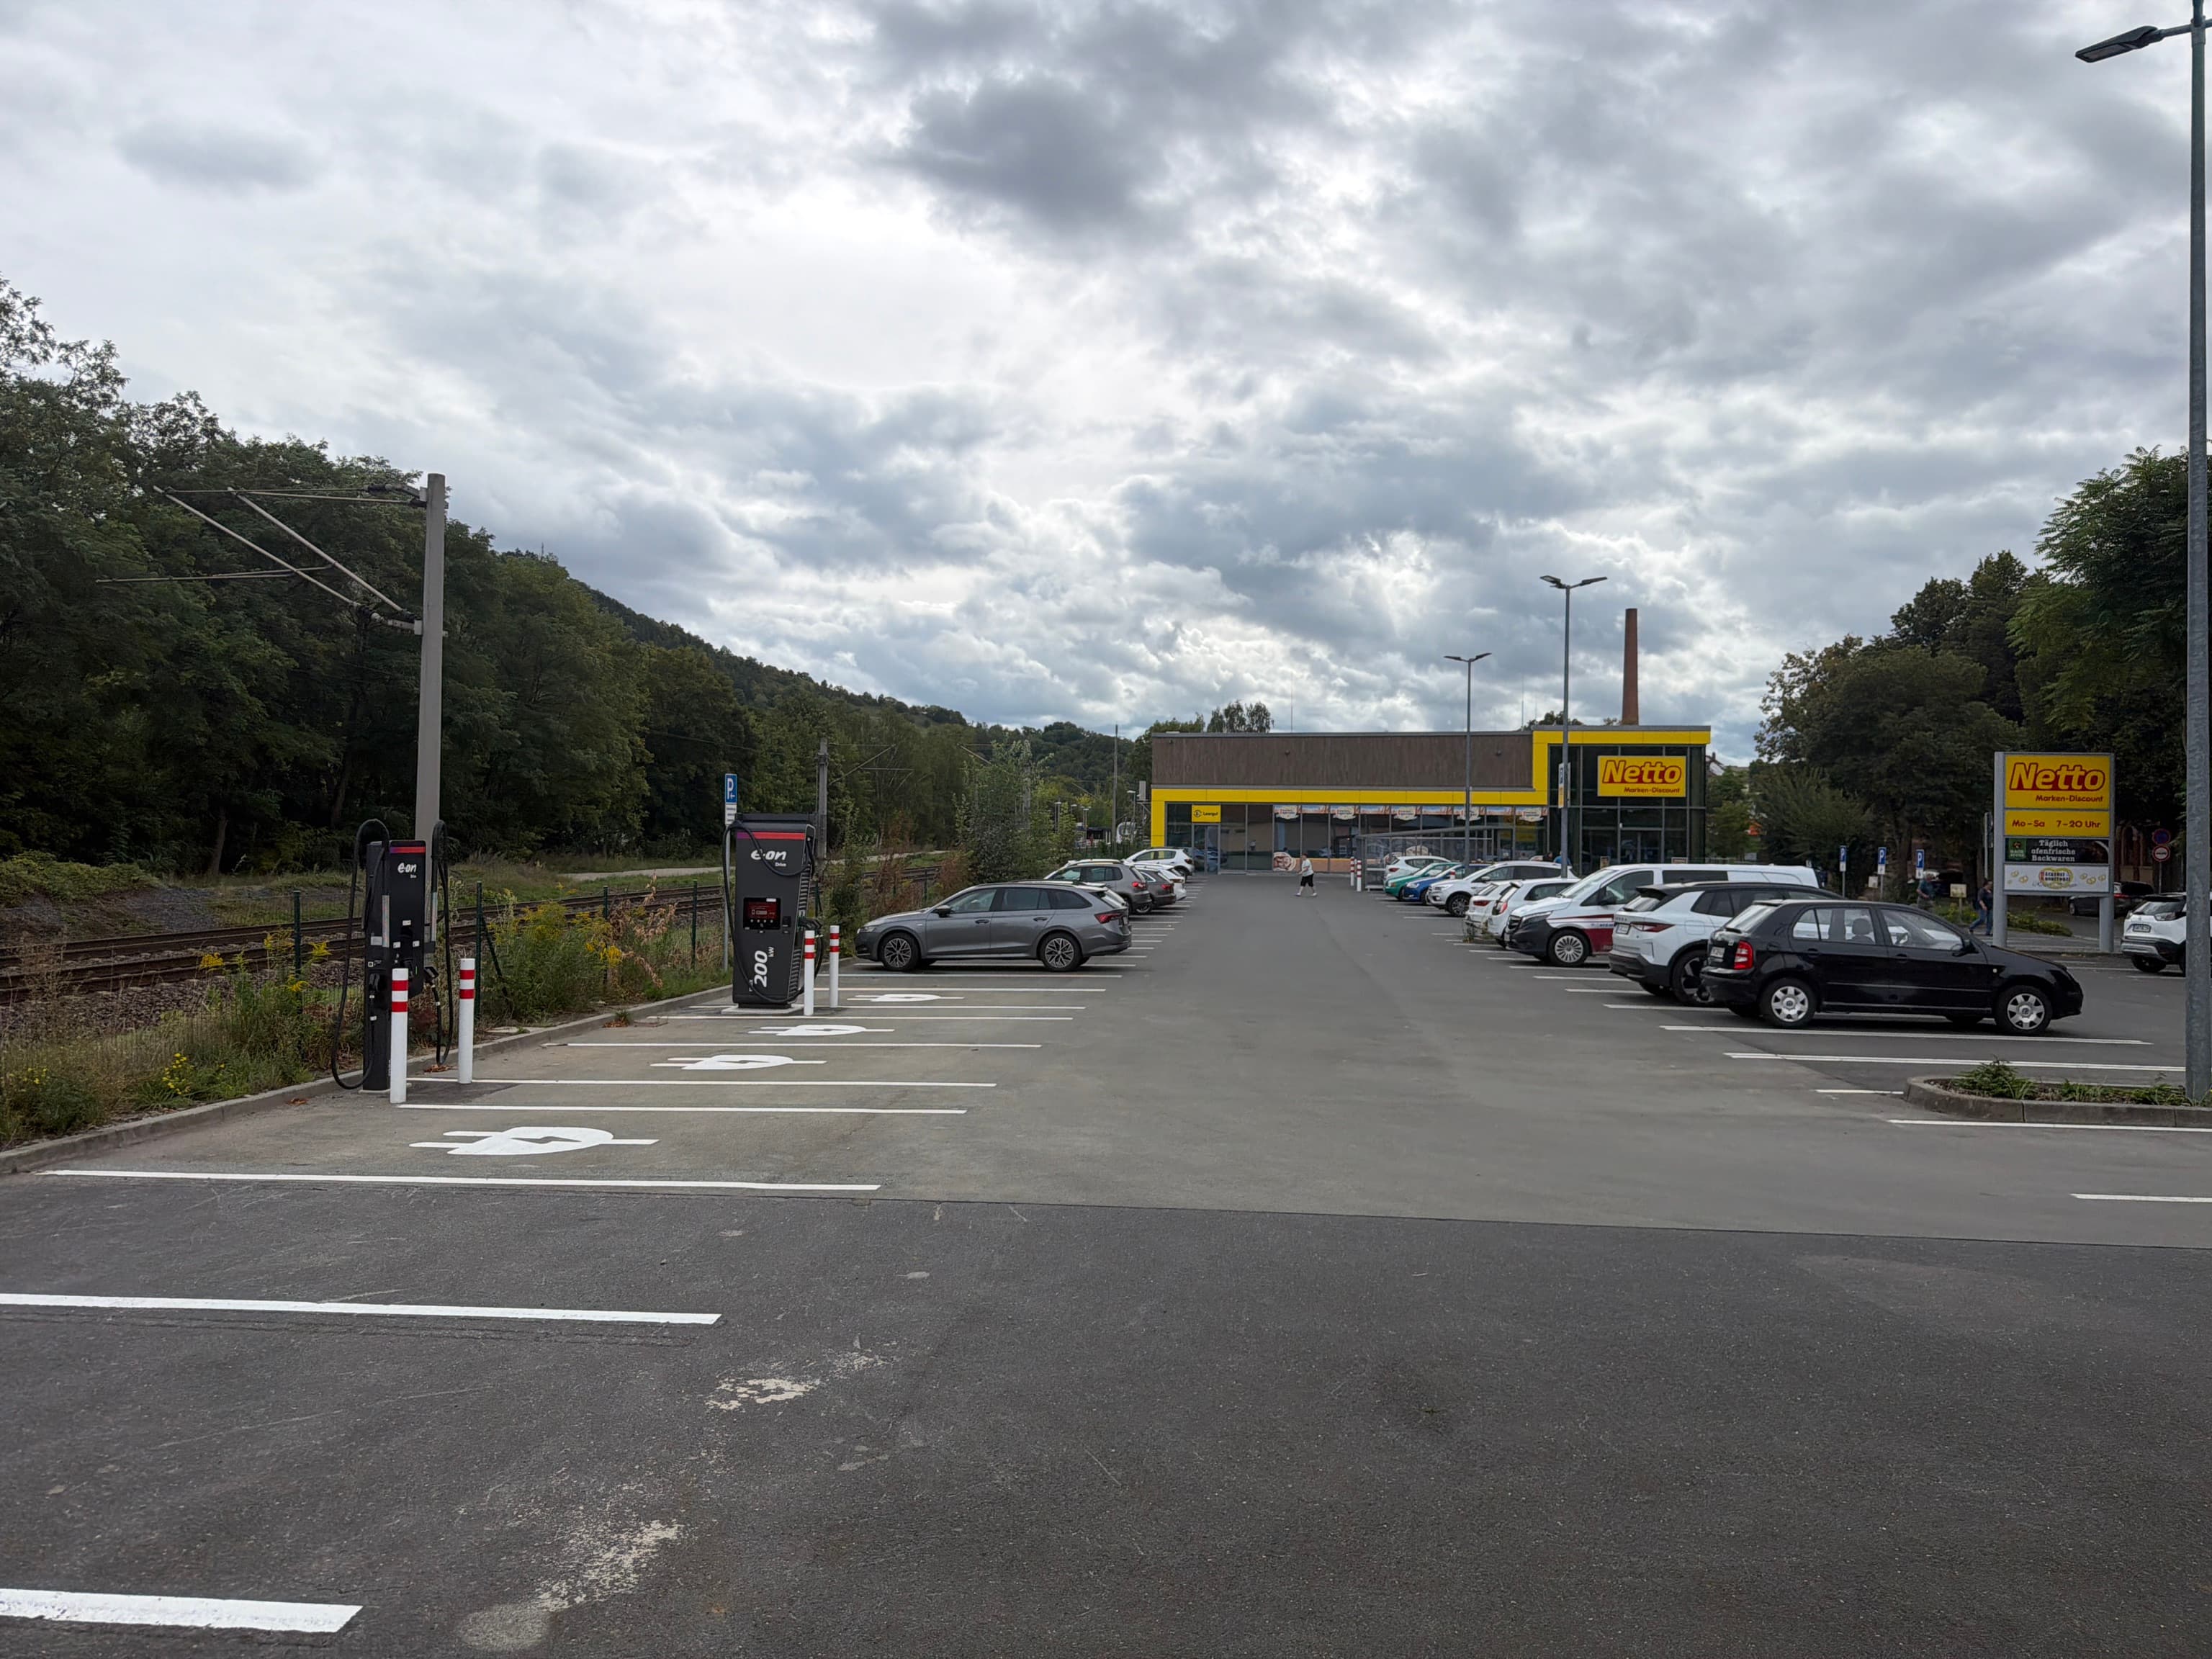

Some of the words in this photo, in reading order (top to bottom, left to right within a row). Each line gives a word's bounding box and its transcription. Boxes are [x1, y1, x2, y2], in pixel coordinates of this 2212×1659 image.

[1602, 760, 1682, 784] Netto
[2009, 762, 2105, 791] Netto
[727, 778, 734, 800] P
[754, 950, 768, 987] 200
